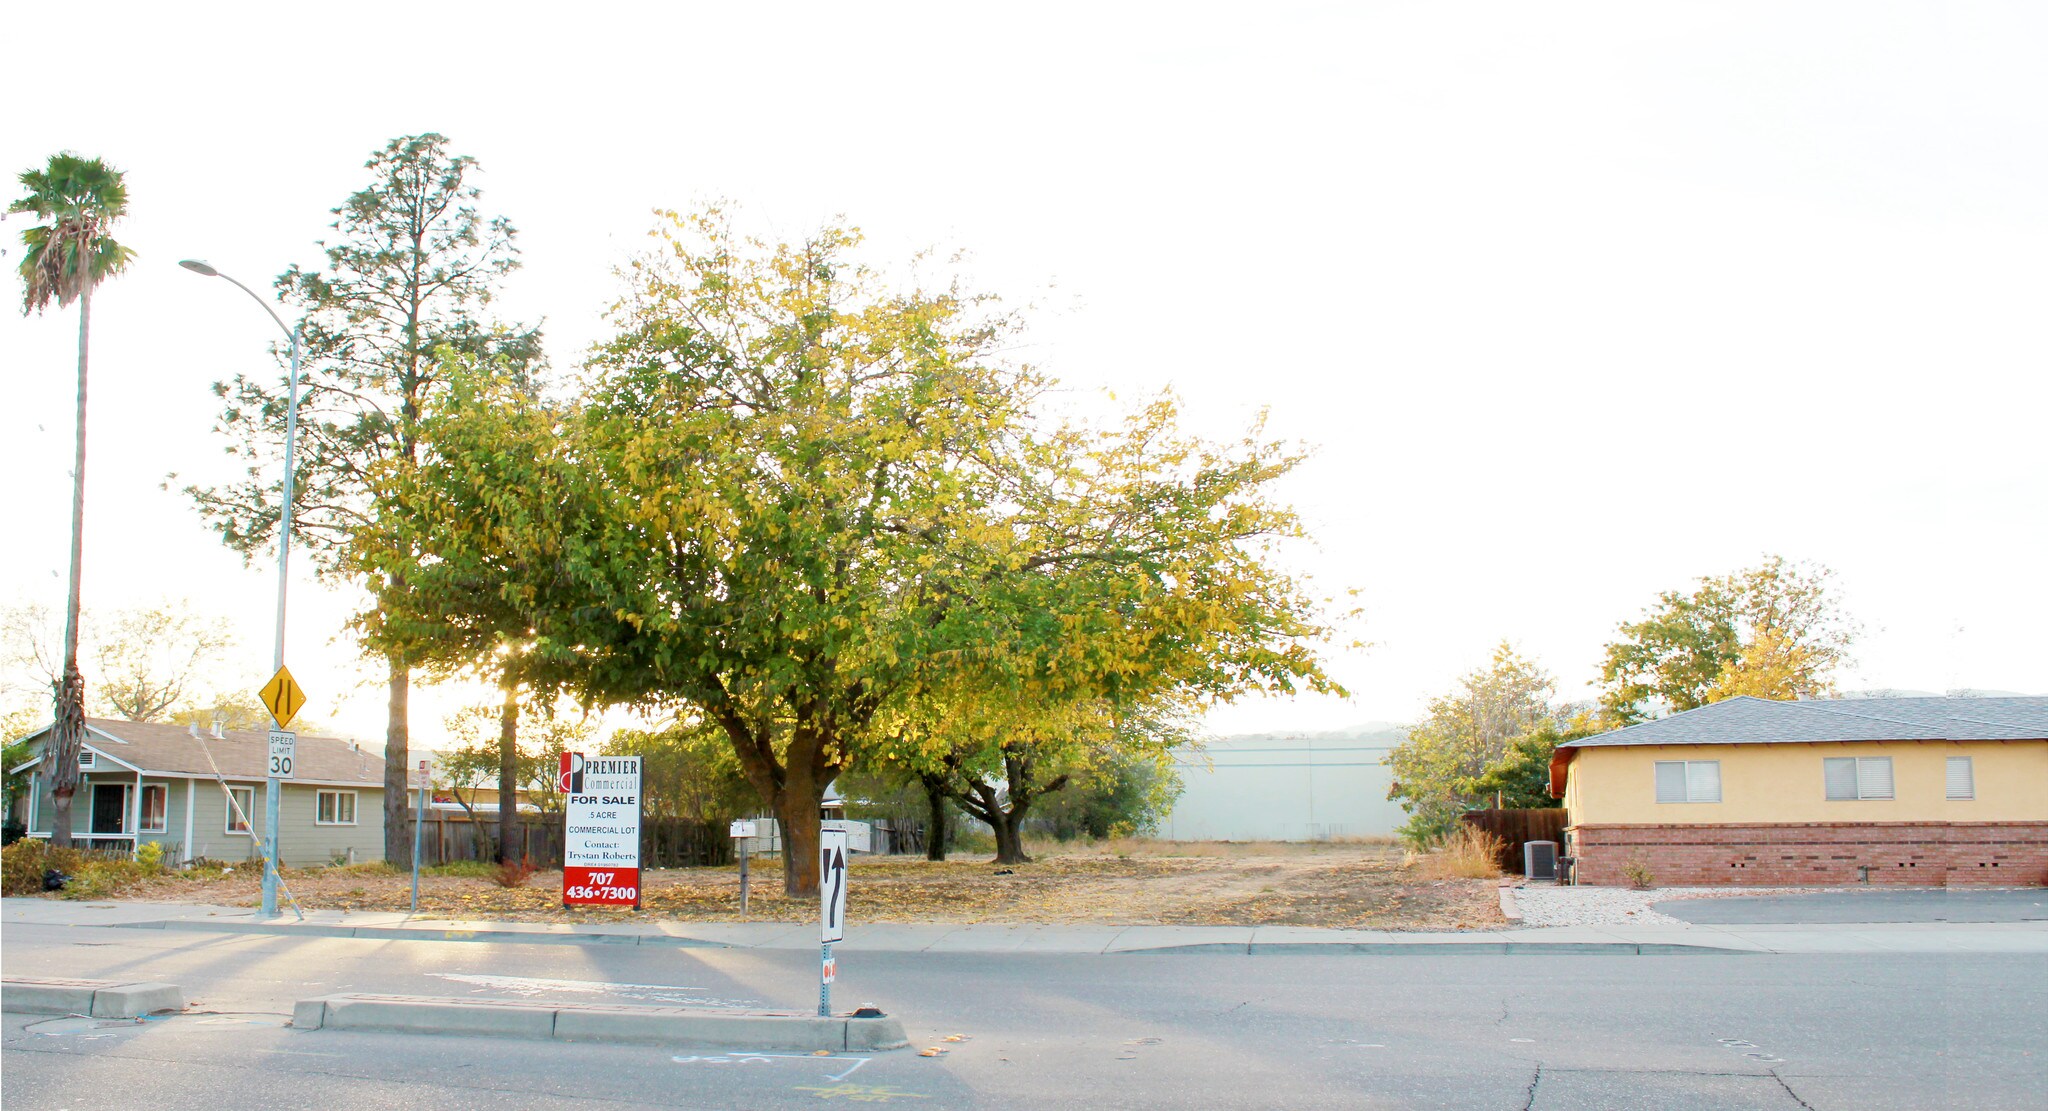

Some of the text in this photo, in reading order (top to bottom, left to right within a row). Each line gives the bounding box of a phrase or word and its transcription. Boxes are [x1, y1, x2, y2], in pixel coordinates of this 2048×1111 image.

[271, 736, 293, 745] SPEED
[272, 747, 290, 755] LIMIT
[270, 756, 292, 774] 30
[585, 760, 637, 774] PREMIER
[585, 777, 637, 790] Commercial
[571, 796, 635, 805] FOR SALE
[588, 811, 617, 819] .5 ACRE
[568, 826, 636, 835] COMMERCIAL LOT
[584, 840, 620, 849] Contact:
[567, 851, 636, 861] Trystan Roberts
[588, 872, 615, 885] 707
